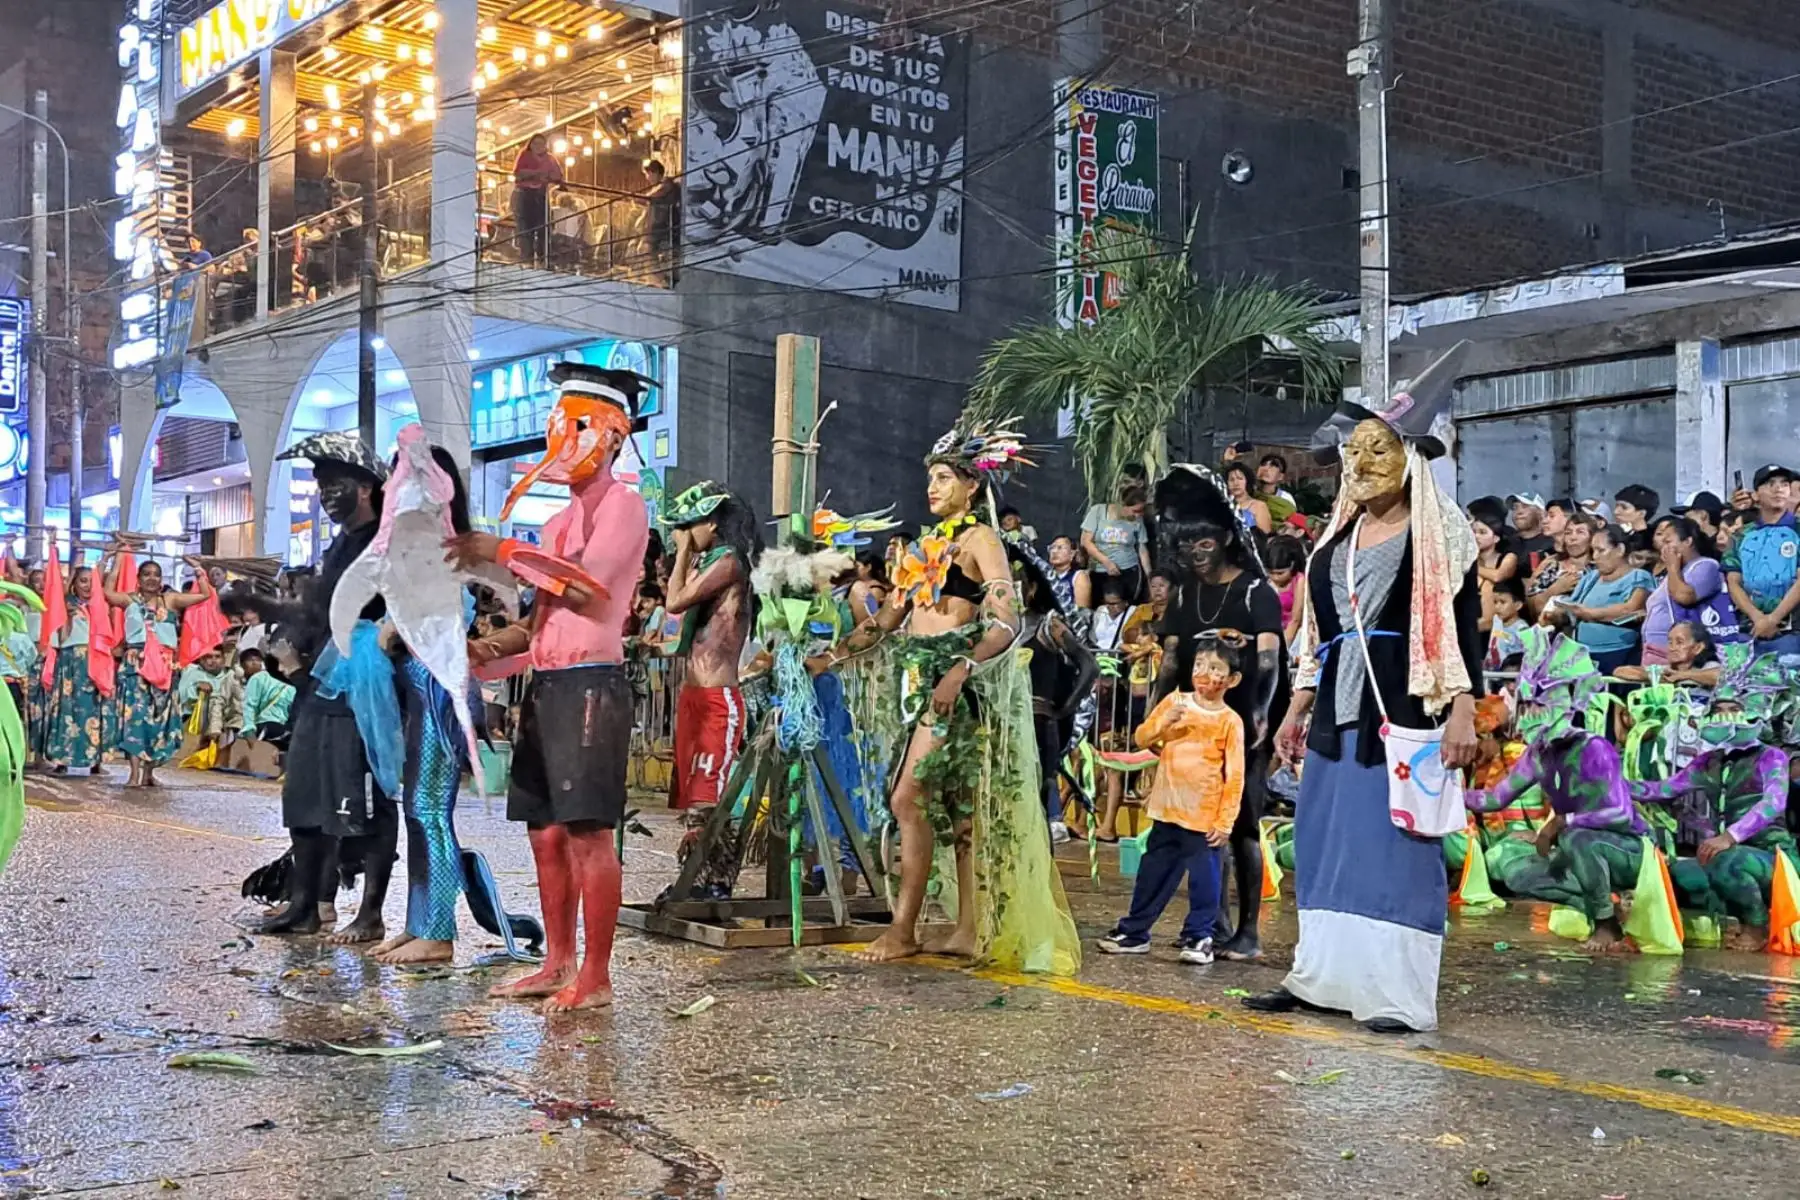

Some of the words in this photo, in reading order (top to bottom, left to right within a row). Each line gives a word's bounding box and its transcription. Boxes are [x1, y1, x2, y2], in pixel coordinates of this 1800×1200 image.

[849, 45, 884, 73] DE
[890, 55, 941, 85] TUS
[827, 67, 950, 111] FAVORITOS
[871, 103, 901, 127] EN
[907, 112, 934, 133] TU
[827, 122, 940, 186] MANU
[808, 196, 921, 232] CERCANO
